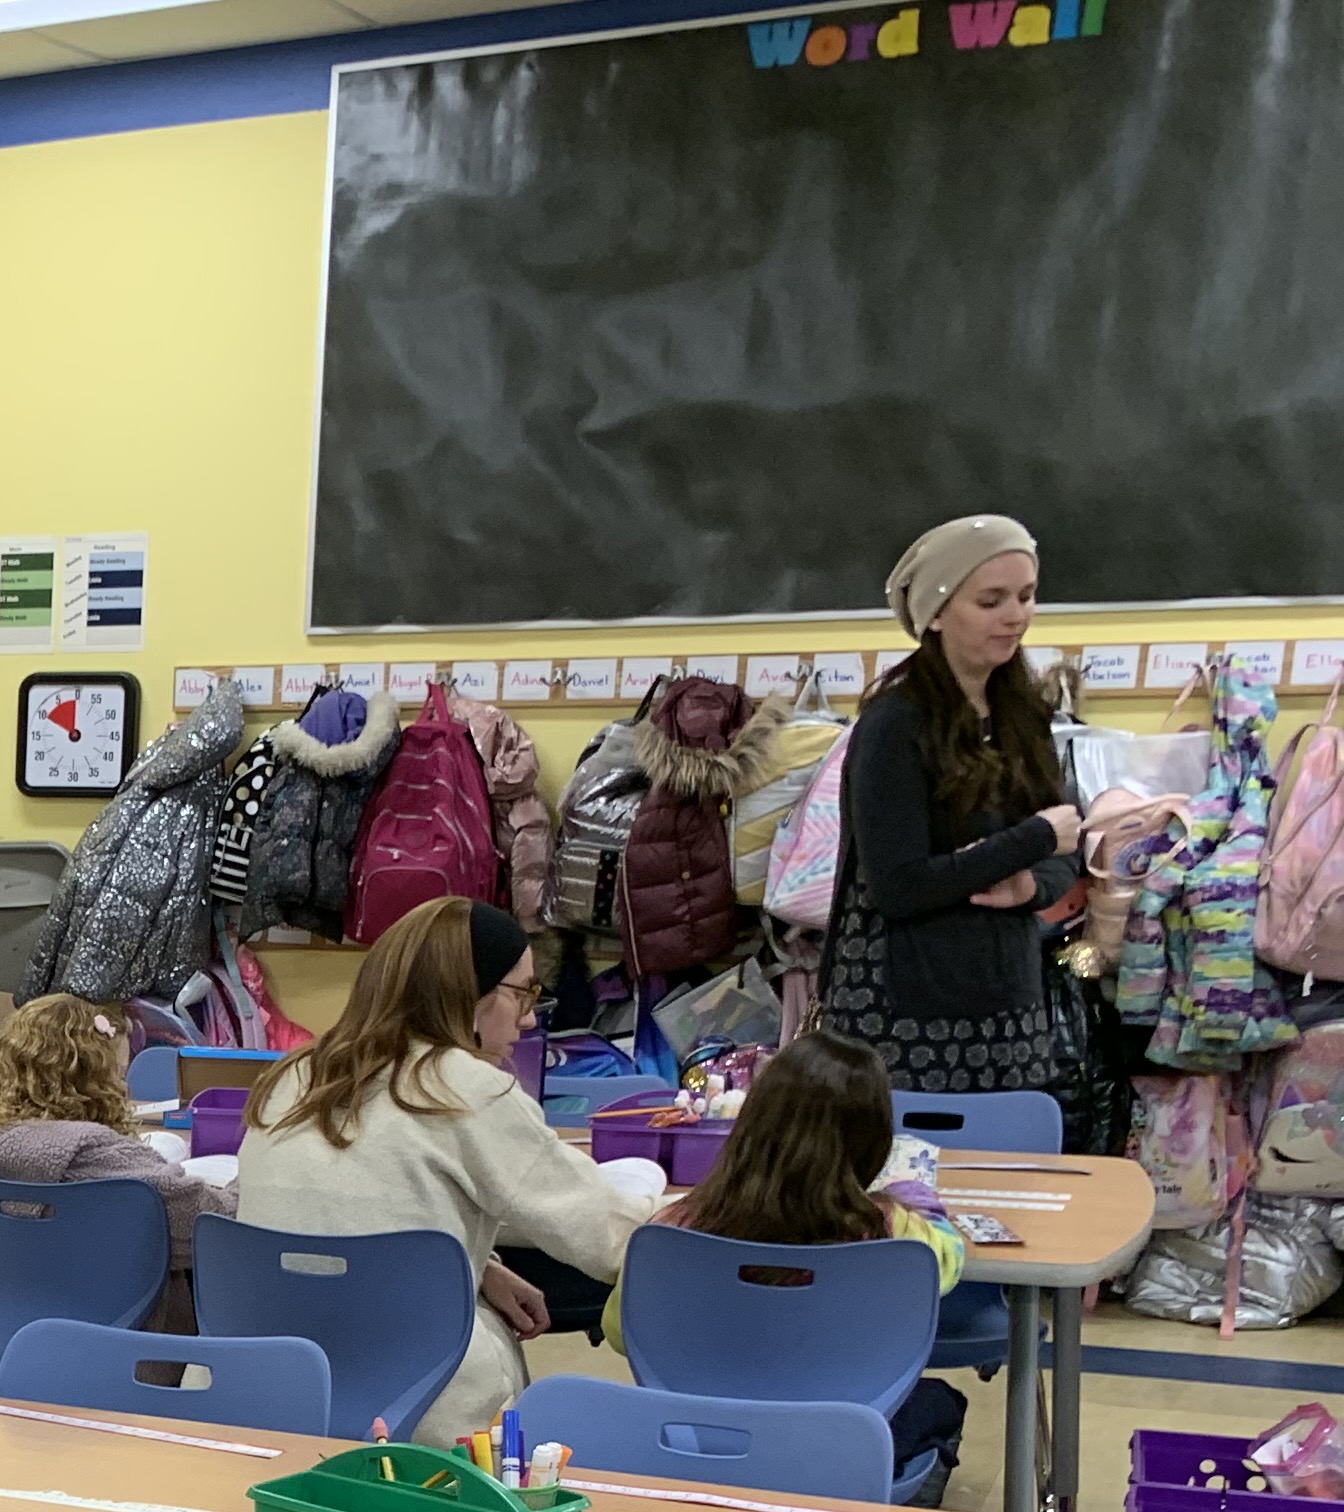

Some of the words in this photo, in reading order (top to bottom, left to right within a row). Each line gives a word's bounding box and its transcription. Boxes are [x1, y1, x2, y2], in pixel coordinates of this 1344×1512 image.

[747, 8, 920, 69] Word
[948, 0, 1107, 49] Wall
[573, 674, 610, 688] Daniel
[91, 694, 102, 704] 55
[105, 710, 116, 720] 50
[32, 731, 41, 741] 15
[110, 732, 120, 741] 45
[35, 751, 44, 761] 20
[103, 752, 113, 761] 40
[49, 768, 59, 777] 25
[68, 772, 79, 782] 30
[88, 768, 99, 777] 35
